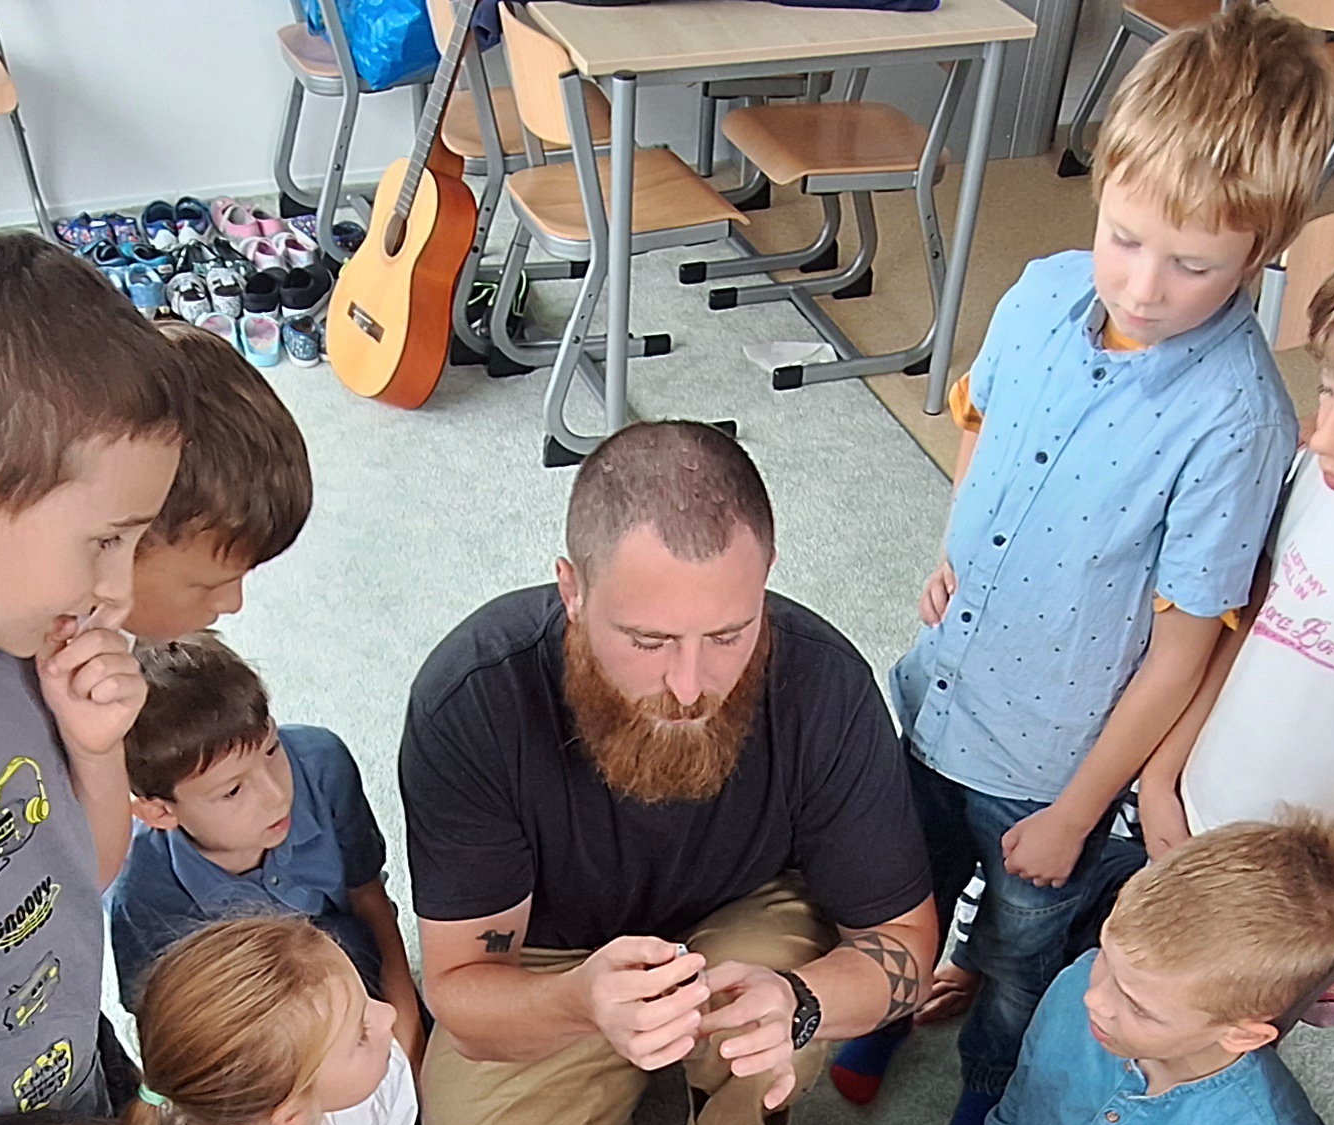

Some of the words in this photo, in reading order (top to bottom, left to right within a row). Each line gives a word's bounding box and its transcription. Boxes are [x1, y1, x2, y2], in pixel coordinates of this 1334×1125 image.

[1290, 546, 1307, 575] LEFT
[1305, 574, 1327, 597] MY
[1294, 584, 1308, 600] IN
